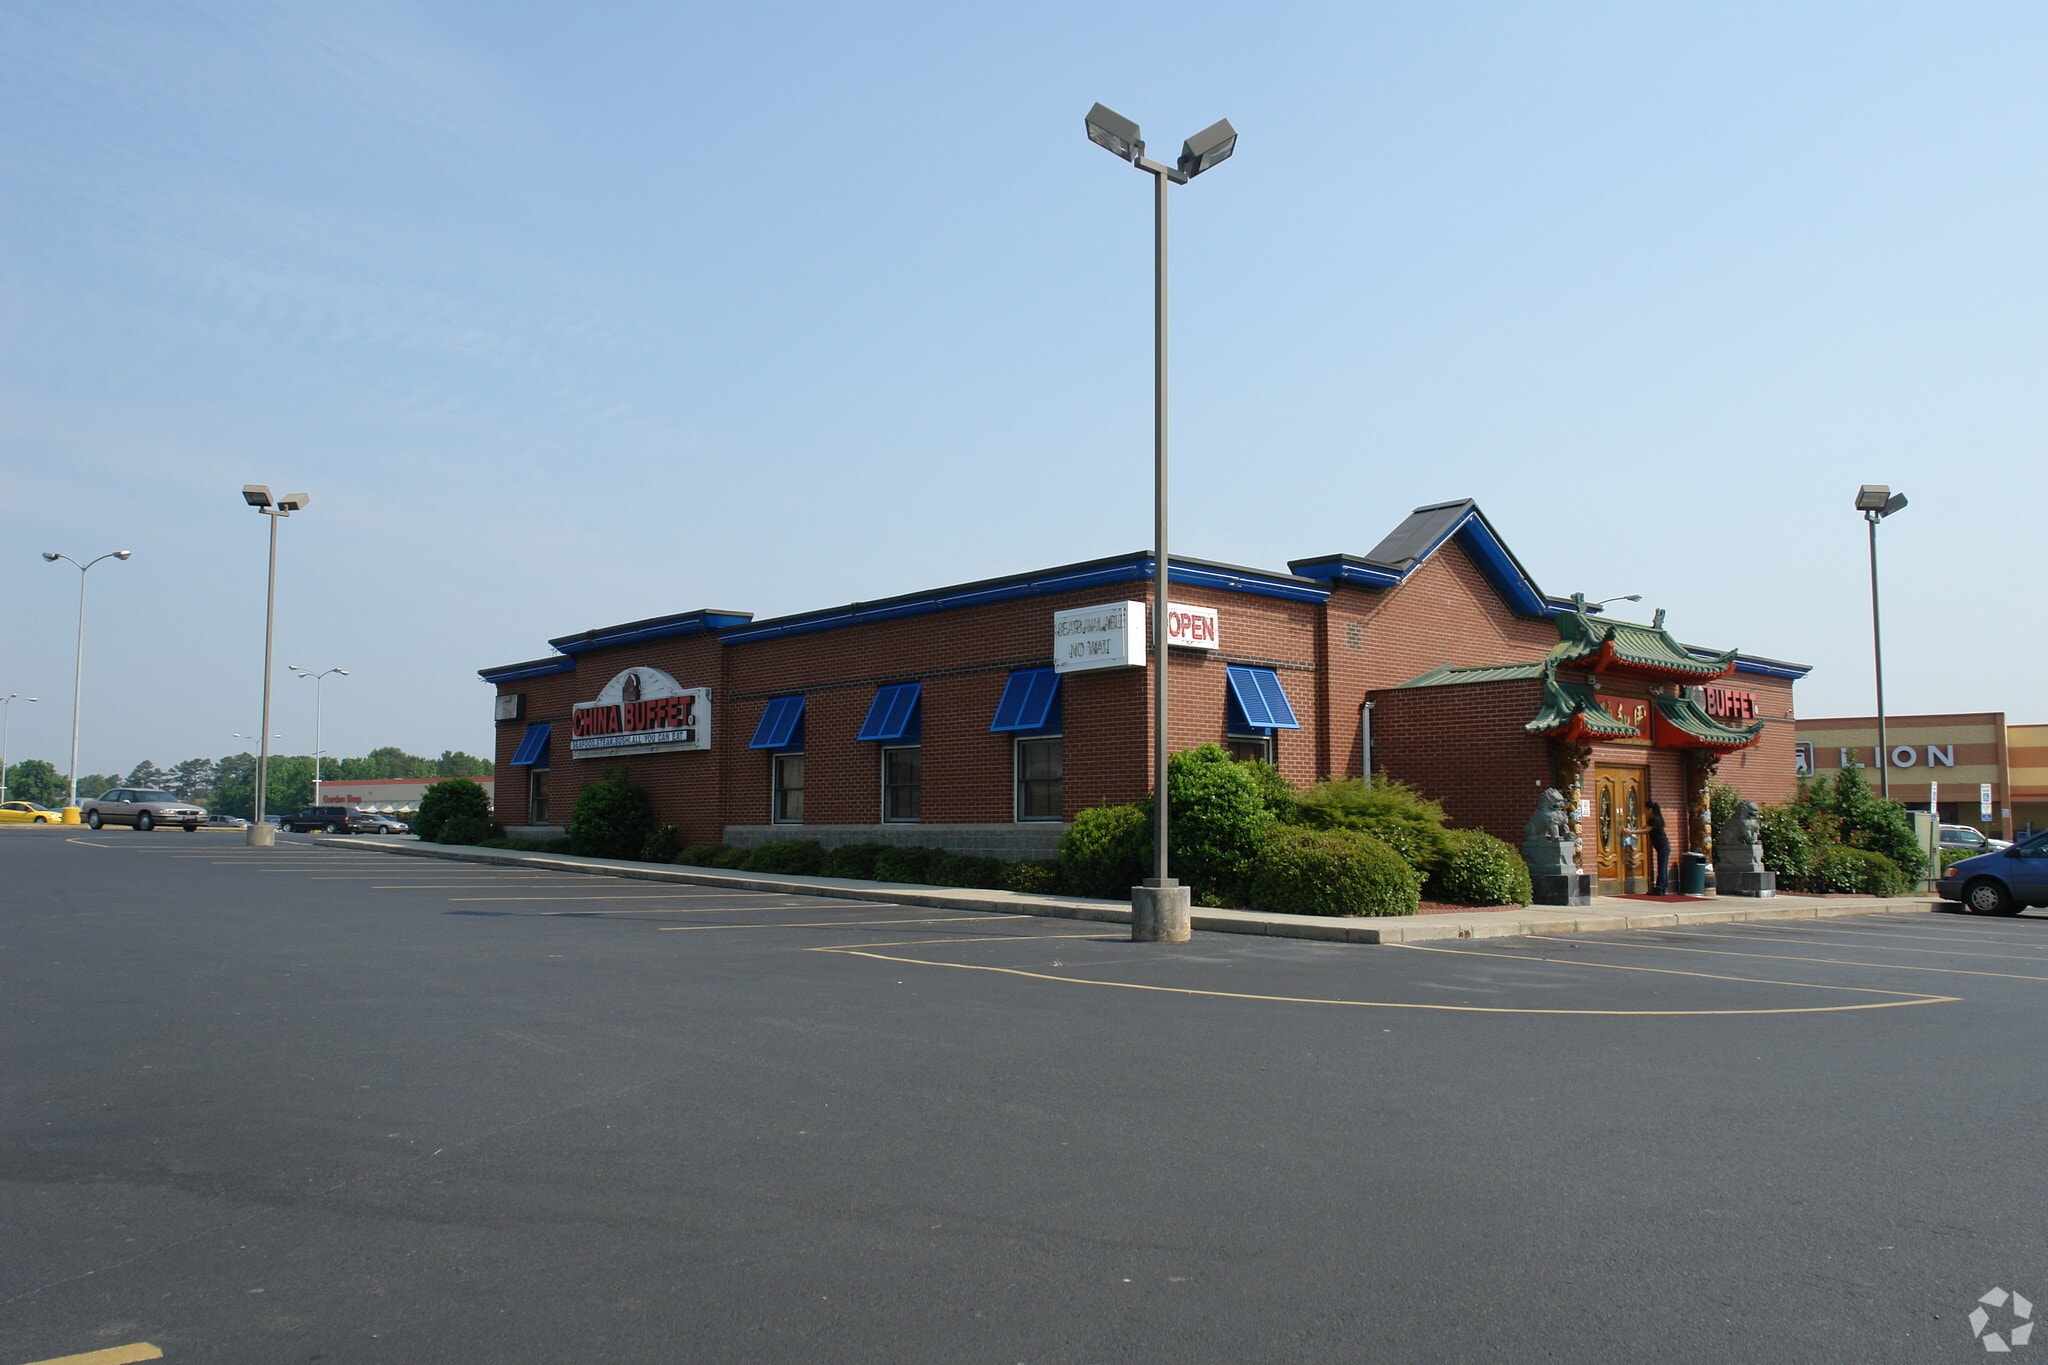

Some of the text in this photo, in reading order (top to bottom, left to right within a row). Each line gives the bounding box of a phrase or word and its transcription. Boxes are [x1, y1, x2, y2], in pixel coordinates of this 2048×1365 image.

[1168, 611, 1215, 642] OPEN
[1069, 639, 1111, 658] NO WAIT
[573, 696, 691, 736] CHINA BUFFET
[1707, 688, 1757, 719] BUFFET
[644, 734, 656, 743] YOU
[658, 733, 670, 742] CAN
[672, 732, 684, 741] EAT
[1840, 744, 1954, 769] LION
